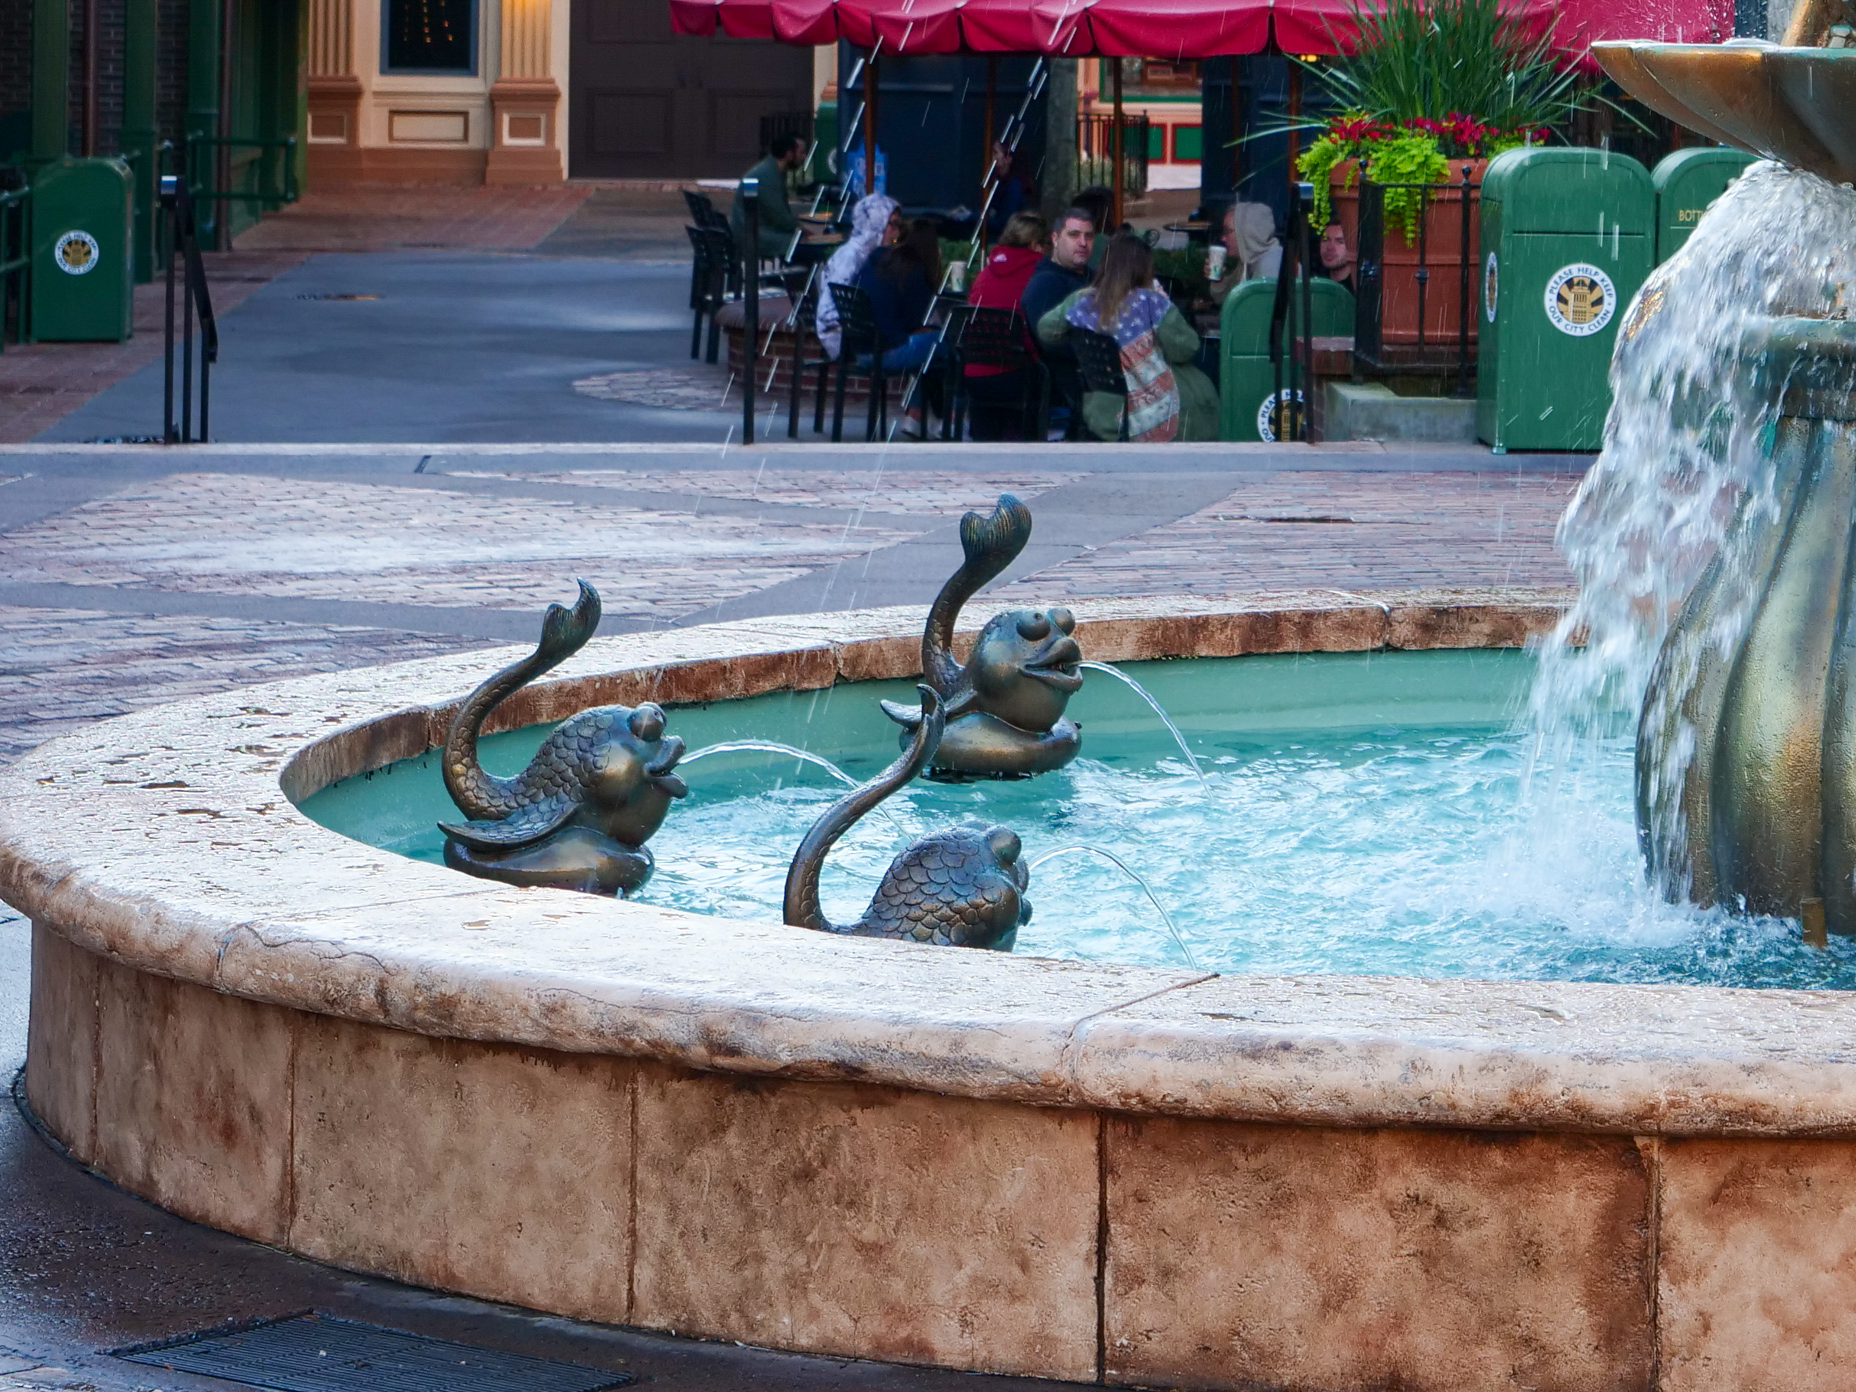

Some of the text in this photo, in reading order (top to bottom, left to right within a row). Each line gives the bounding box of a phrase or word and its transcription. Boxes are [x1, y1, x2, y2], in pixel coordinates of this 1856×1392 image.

[1678, 209, 1703, 222] BOTT
[1549, 267, 1614, 299] PLEASE HELP KEEP
[1549, 305, 1612, 333] OUR CITY CLEAN
[1261, 394, 1276, 418] PLEA
